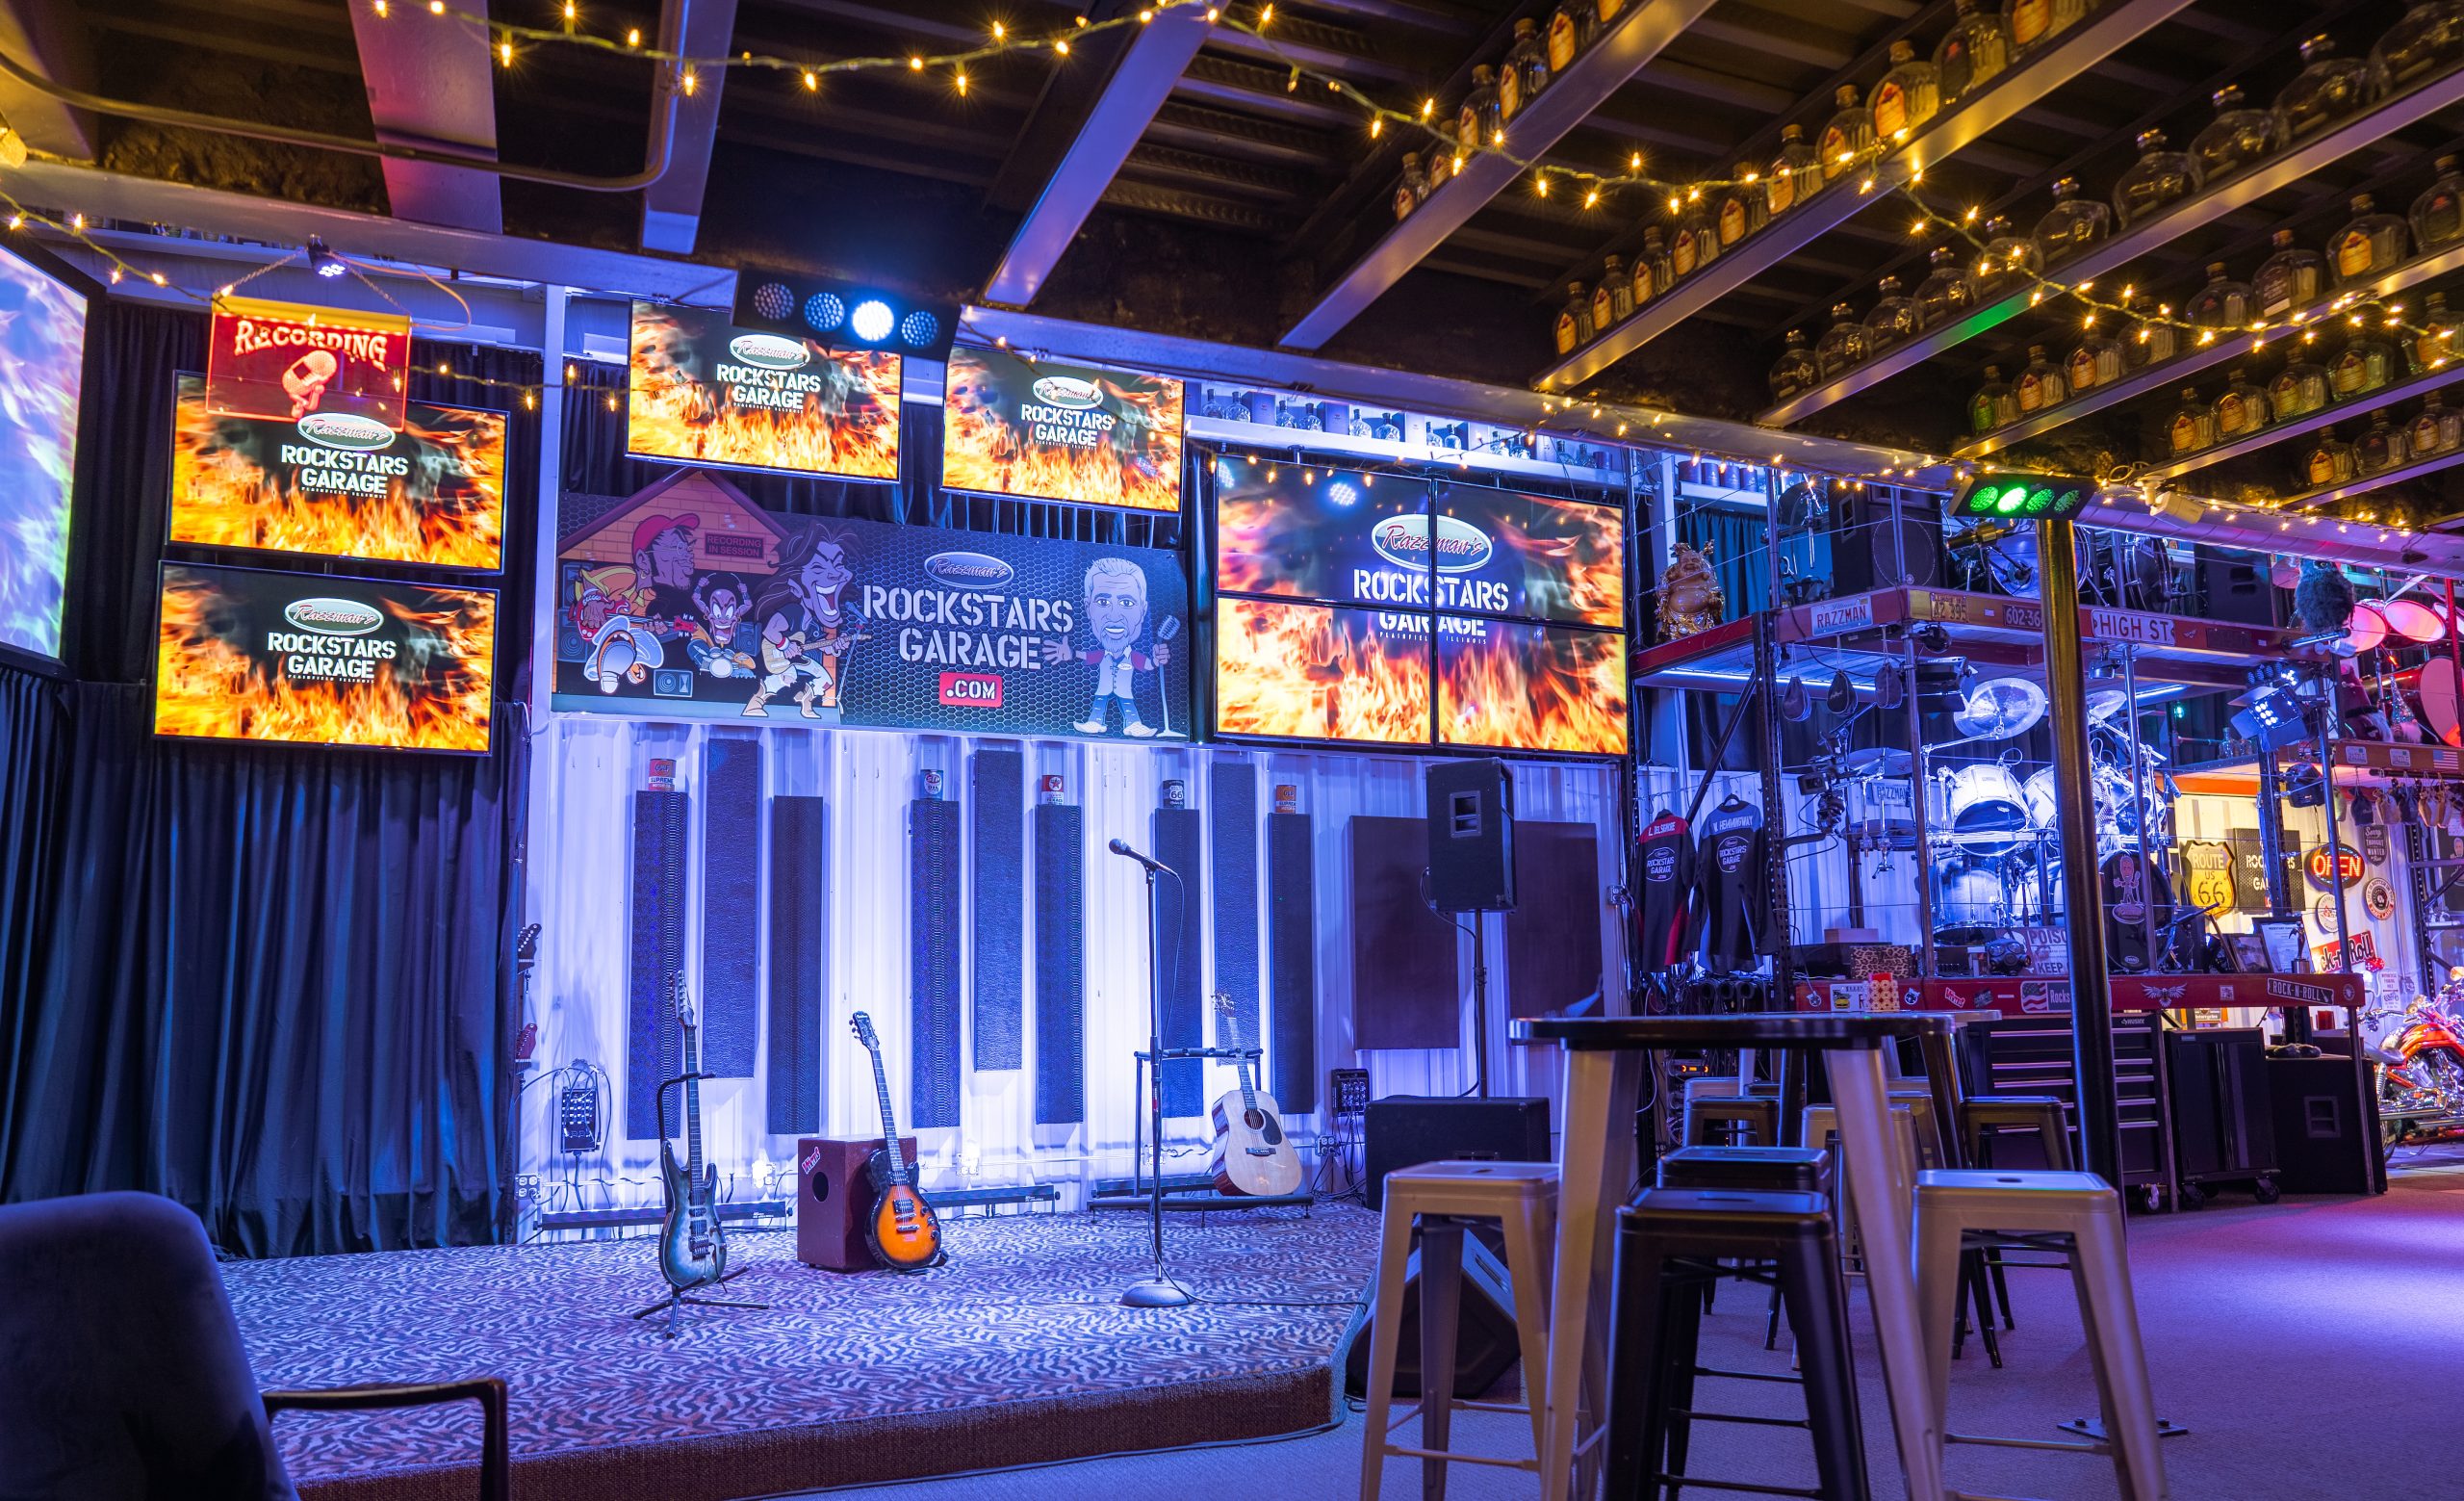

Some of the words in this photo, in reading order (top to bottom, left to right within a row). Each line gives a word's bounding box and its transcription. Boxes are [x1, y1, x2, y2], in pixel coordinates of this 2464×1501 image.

[716, 364, 822, 393] ROCKSTARS
[732, 385, 805, 409] GARAGE
[1021, 403, 1113, 431] ROCKSTARS
[1035, 424, 1097, 447] GARAGE
[281, 444, 409, 476] ROCKSTARS
[301, 467, 388, 494] GARAGE
[706, 535, 761, 548] RECORDING
[708, 545, 719, 554] IN
[720, 546, 760, 556] SESSION
[1382, 525, 1484, 556] Razzman's
[932, 556, 1009, 578] Razzman's
[1353, 569, 1509, 611] ROCKSTARS
[294, 605, 377, 625] Razzman's
[863, 584, 1074, 633] ROCKSTARS
[1816, 606, 1866, 629] RAZZMAN
[2099, 613, 2143, 639] HIGH
[268, 632, 398, 660] ROCKSTARS
[899, 628, 1041, 670] GARAGE
[1378, 632, 1429, 642] PLAINFIEL
[1446, 635, 1488, 645] ILLINOIS
[288, 655, 376, 679] GARAGE
[946, 680, 995, 700] .COM
[1170, 790, 1183, 799] 66
[2193, 853, 2224, 869] ROUTE
[2204, 870, 2216, 880] US
[2198, 881, 2225, 905] 66
[2038, 963, 2064, 973] KEEP
[2272, 980, 2321, 1001] ROCK-N-ROLL
